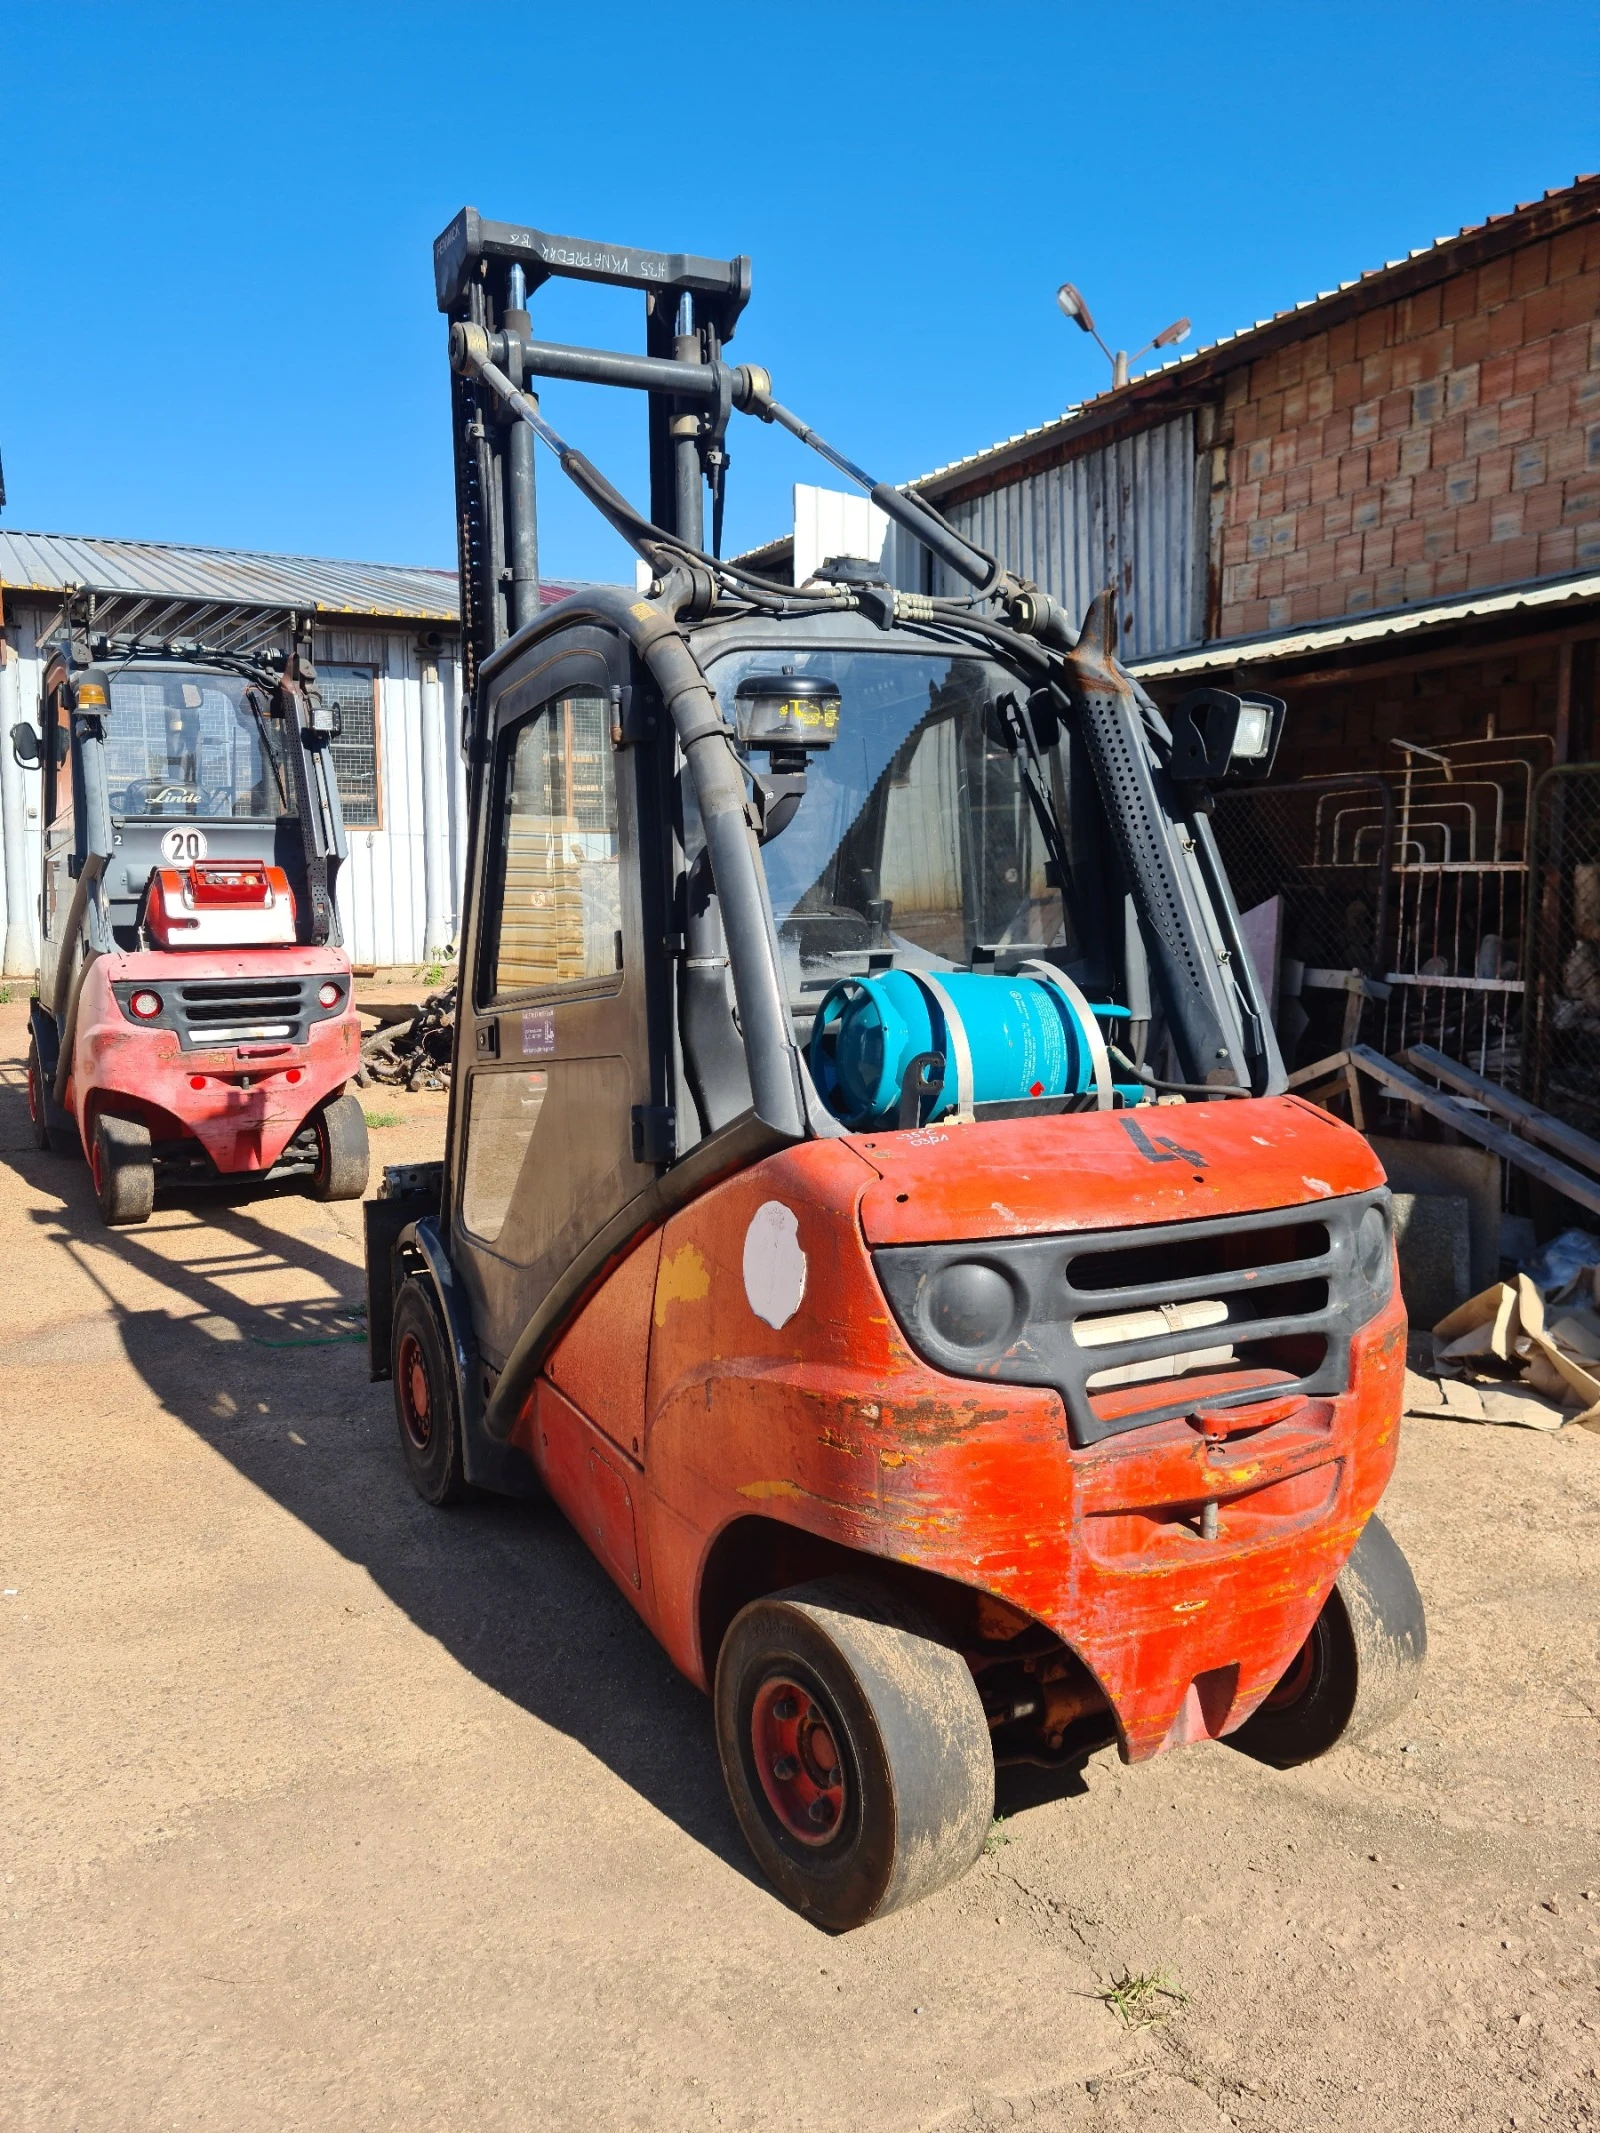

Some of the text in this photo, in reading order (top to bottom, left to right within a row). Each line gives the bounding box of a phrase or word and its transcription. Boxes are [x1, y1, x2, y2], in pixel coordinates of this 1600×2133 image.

[144, 786, 202, 804] Linde
[171, 833, 200, 860] 20
[1118, 1117, 1211, 1168] 4
